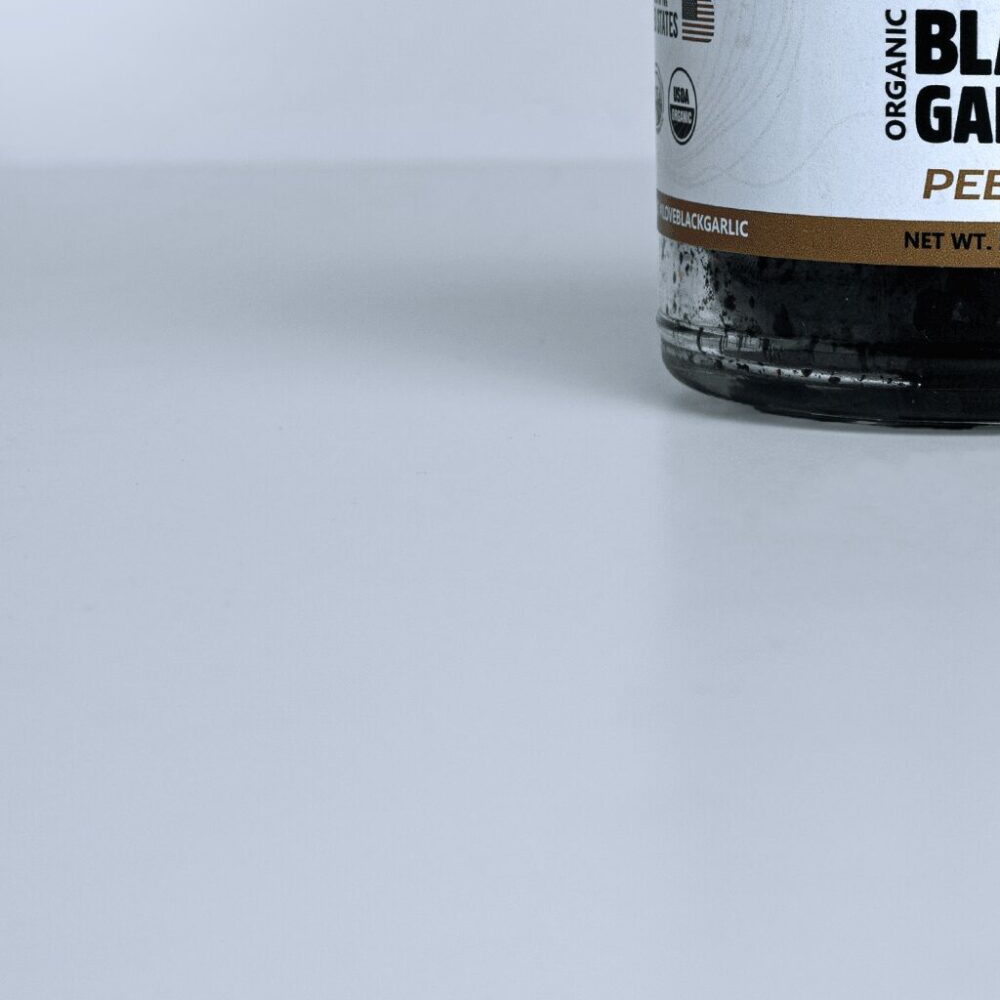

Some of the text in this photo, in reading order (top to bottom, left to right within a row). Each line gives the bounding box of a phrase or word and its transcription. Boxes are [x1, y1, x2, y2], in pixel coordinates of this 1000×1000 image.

[657, 9, 679, 38] STATES
[884, 9, 907, 142] ORGANIC
[673, 86, 690, 104] USDA
[903, 230, 945, 250] NET
[950, 231, 993, 251] WT.
